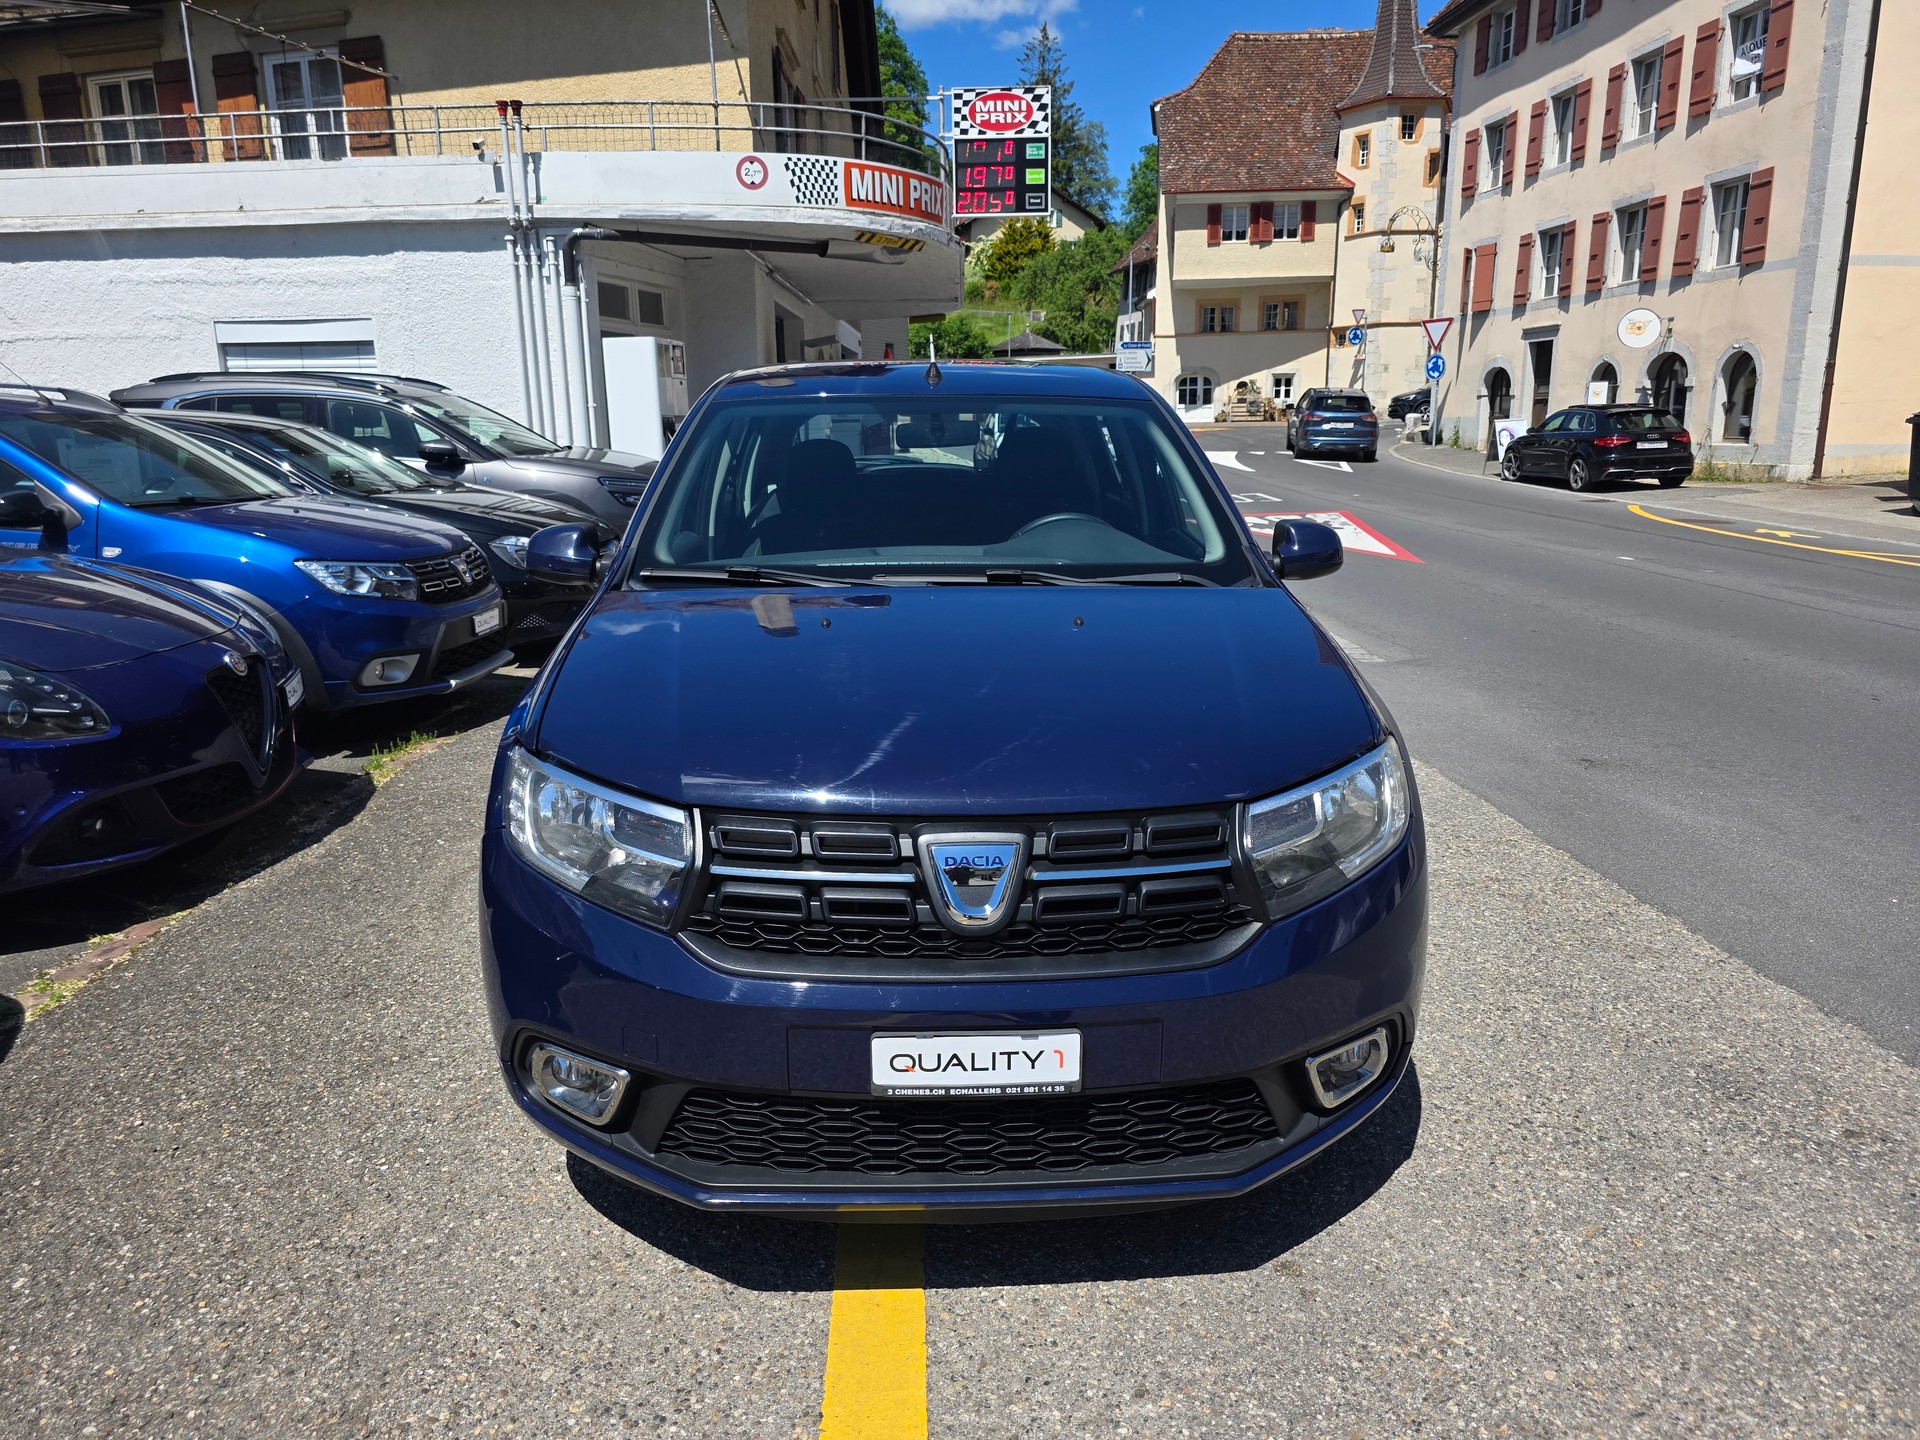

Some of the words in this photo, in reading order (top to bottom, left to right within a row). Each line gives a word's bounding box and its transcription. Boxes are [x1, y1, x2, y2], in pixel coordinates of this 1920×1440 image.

[1745, 37, 1767, 54] LOUE
[975, 100, 1027, 112] MINI
[975, 112, 1027, 124] PRIX
[850, 167, 904, 207] MINI
[909, 178, 943, 217] PRIX
[944, 856, 1005, 867] DACIA
[889, 1050, 1045, 1073] QUALITY
[1053, 1049, 1064, 1068] 1
[950, 1087, 1001, 1095] ECHALLENS
